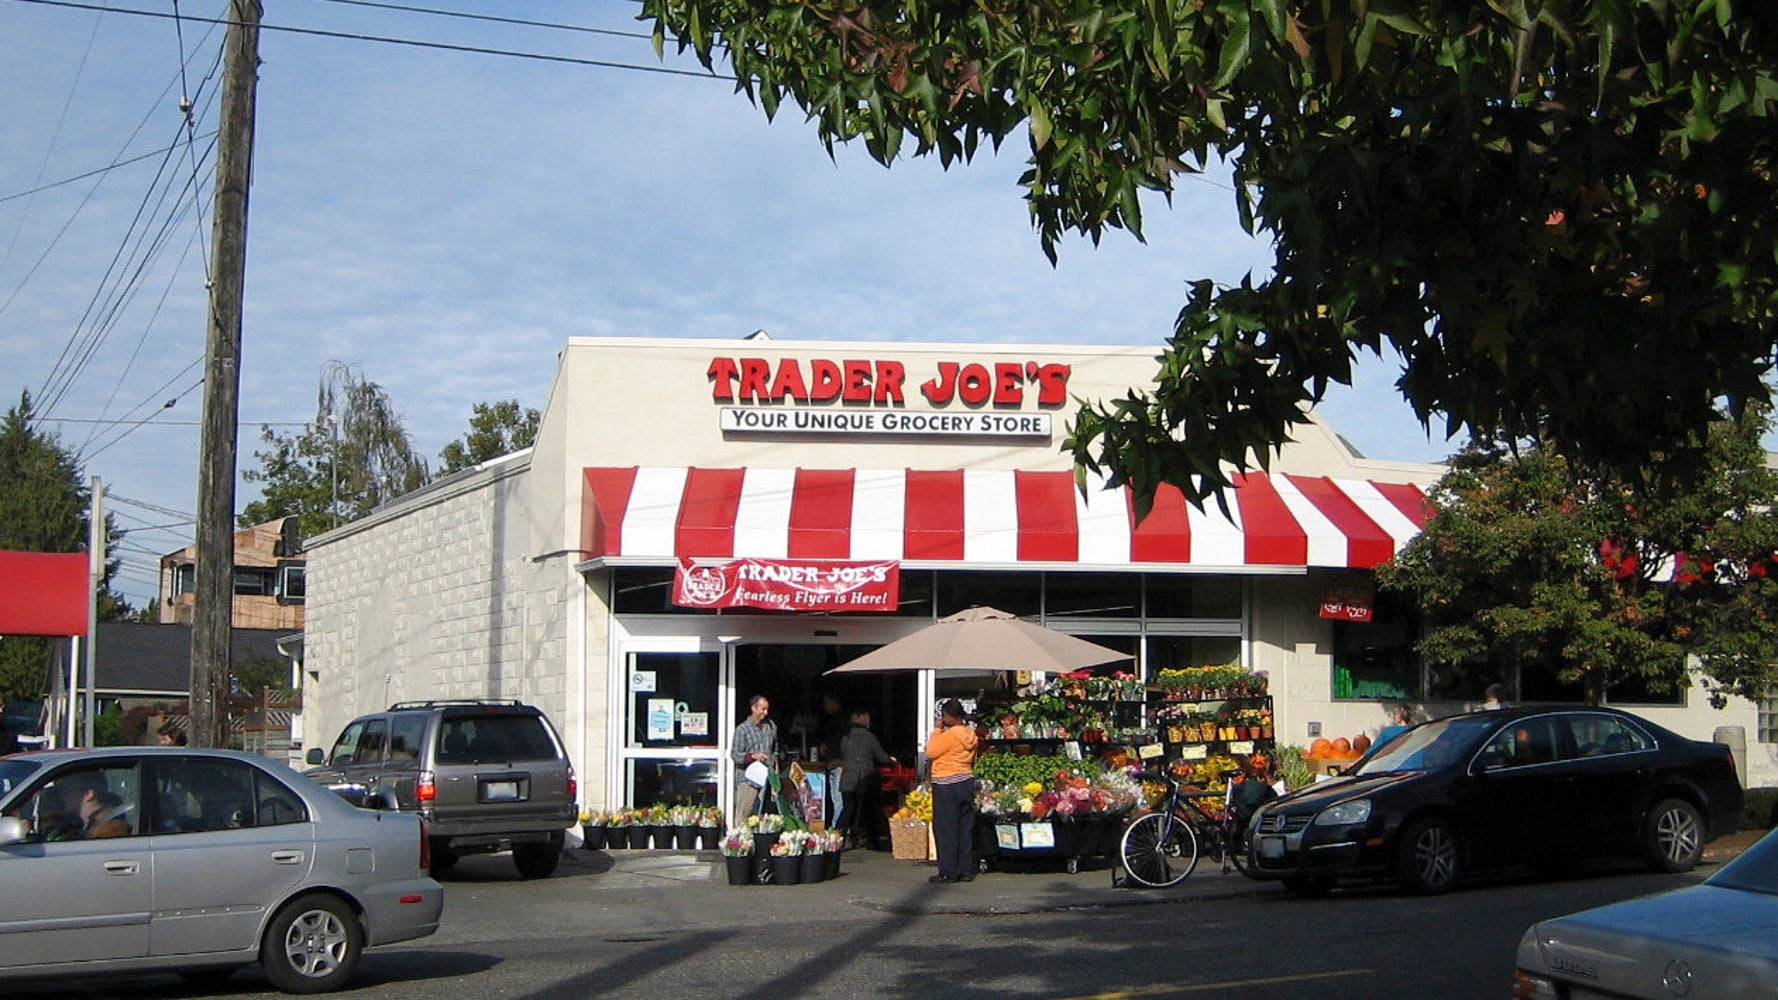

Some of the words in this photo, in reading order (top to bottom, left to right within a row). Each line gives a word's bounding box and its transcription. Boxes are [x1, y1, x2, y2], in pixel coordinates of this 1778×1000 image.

[707, 357, 906, 407] TRADER
[921, 360, 1072, 409] JOE'S
[732, 410, 787, 428] YOUR
[794, 412, 874, 430] UNIQUE
[882, 413, 974, 430] GROCERY
[980, 415, 1042, 432] STORE
[738, 564, 819, 582] TRADER
[826, 565, 887, 582] JOE'S
[735, 587, 791, 603] Fearless
[795, 591, 831, 606] Flyer
[834, 592, 847, 603] is
[851, 591, 888, 604] Here!
